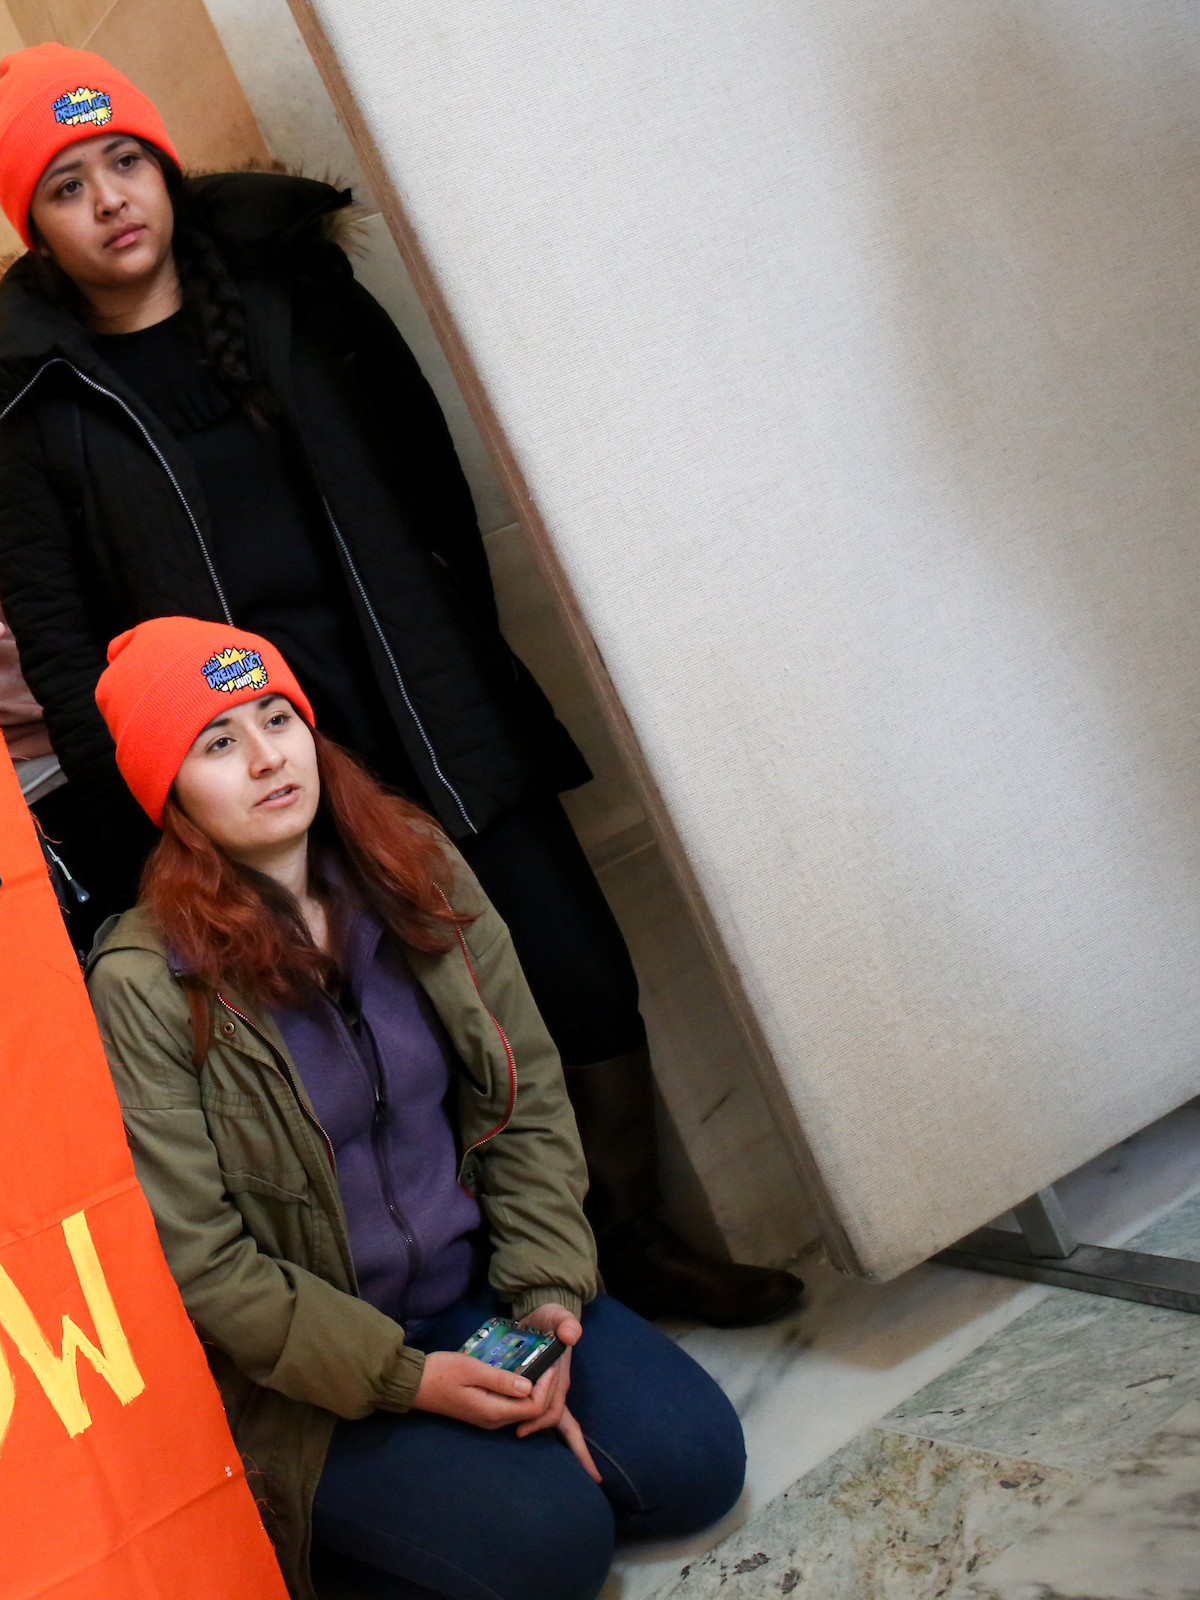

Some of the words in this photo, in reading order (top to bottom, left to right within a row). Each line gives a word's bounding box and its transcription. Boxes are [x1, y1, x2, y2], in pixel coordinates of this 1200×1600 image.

[55, 100, 91, 122] DREAM
[91, 95, 110, 110] ACT
[201, 659, 221, 676] CLEAN
[206, 661, 245, 689] DREAM
[243, 652, 262, 672] ACT
[234, 673, 252, 690] UWD
